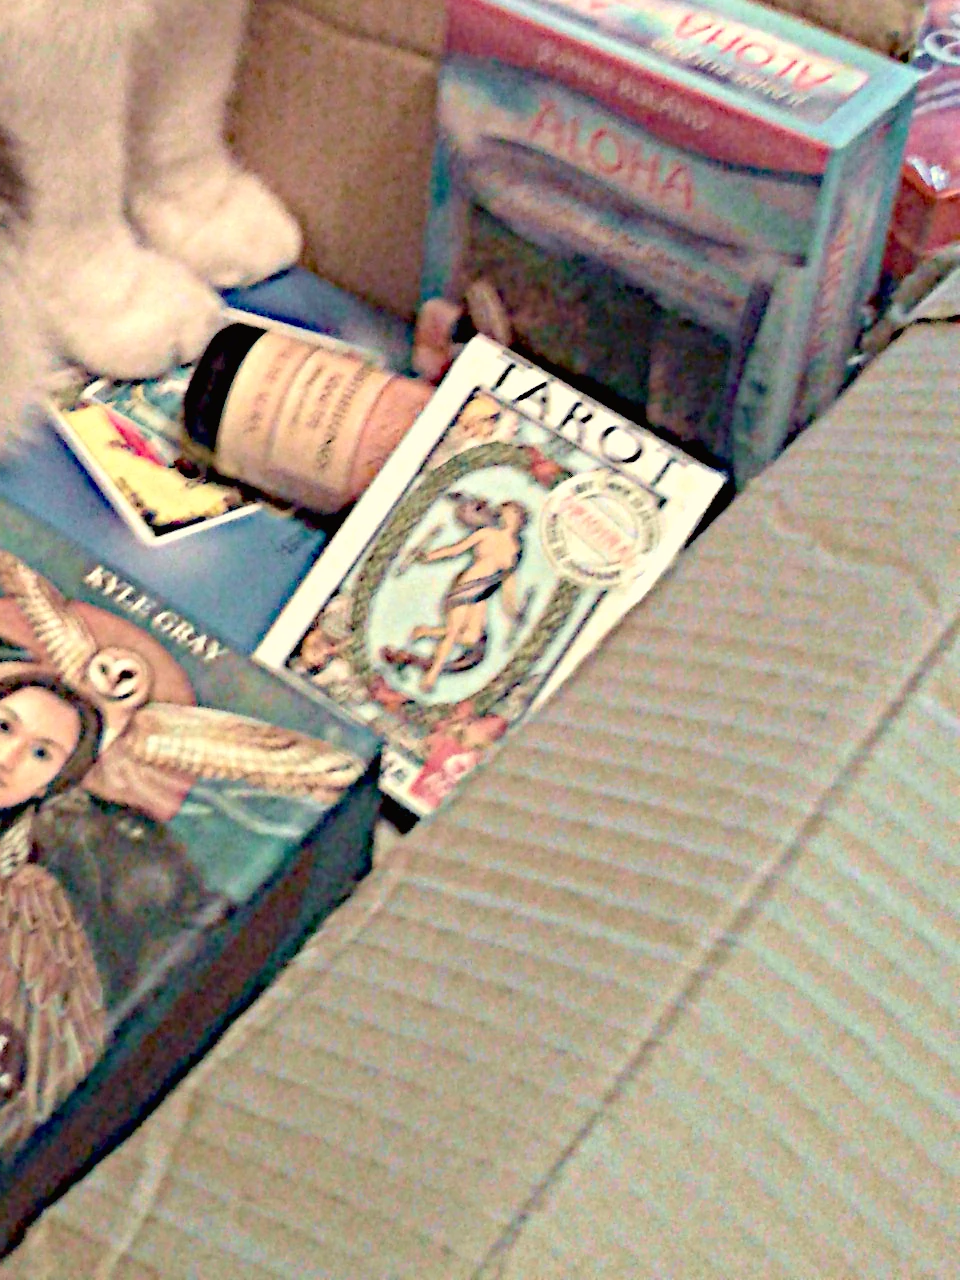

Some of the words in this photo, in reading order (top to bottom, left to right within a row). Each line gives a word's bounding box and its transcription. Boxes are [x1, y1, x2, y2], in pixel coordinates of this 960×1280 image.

[674, 13, 834, 92] ALOHA
[527, 99, 698, 211] ALOHA
[492, 354, 687, 487] TAROT
[83, 565, 157, 619] KYLE
[151, 610, 230, 665] GRAY
